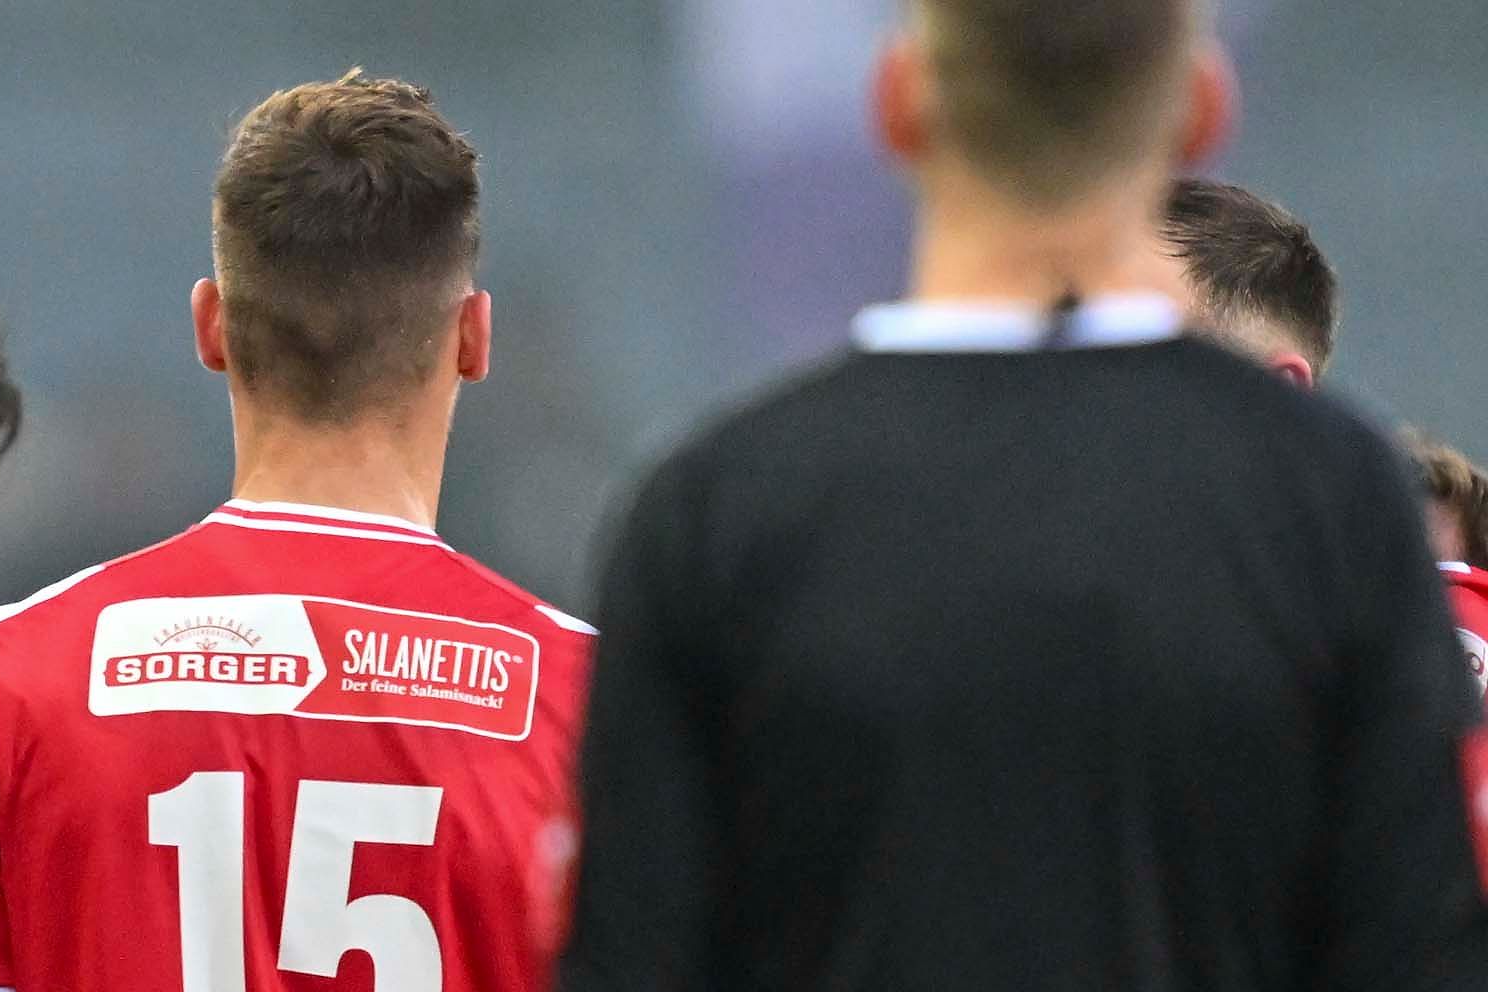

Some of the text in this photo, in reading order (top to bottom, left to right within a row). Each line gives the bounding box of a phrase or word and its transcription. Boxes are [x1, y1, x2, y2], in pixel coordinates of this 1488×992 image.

[116, 654, 297, 683] SORGER
[341, 677, 504, 709] Der feine Salamisnack!
